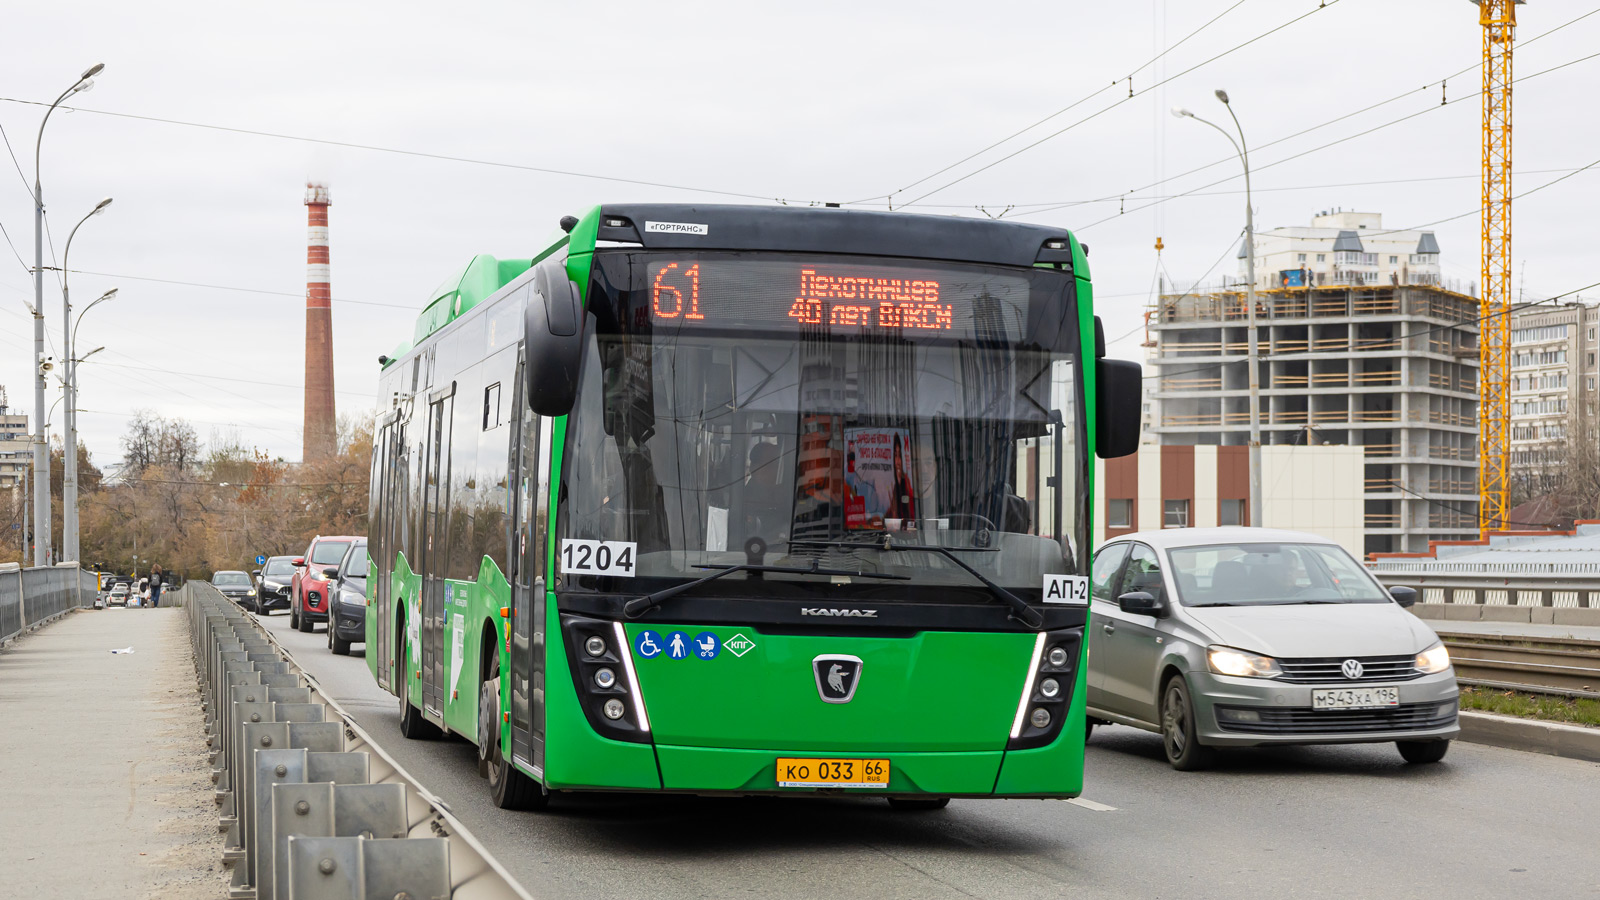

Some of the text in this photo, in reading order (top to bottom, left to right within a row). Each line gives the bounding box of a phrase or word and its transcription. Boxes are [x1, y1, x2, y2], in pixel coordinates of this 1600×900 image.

[651, 223, 703, 233] «ГОРТРАНС»
[653, 262, 704, 319] 61
[801, 269, 940, 302] Пехотинцев
[788, 297, 952, 329] 40 лет ВЛКСМ
[563, 543, 633, 572] 1204
[1047, 579, 1086, 600] АП-2
[801, 607, 878, 618] KAMAZ
[730, 641, 748, 649] КПГ
[1375, 689, 1397, 701] 196
[787, 761, 883, 780] КО 033 66
